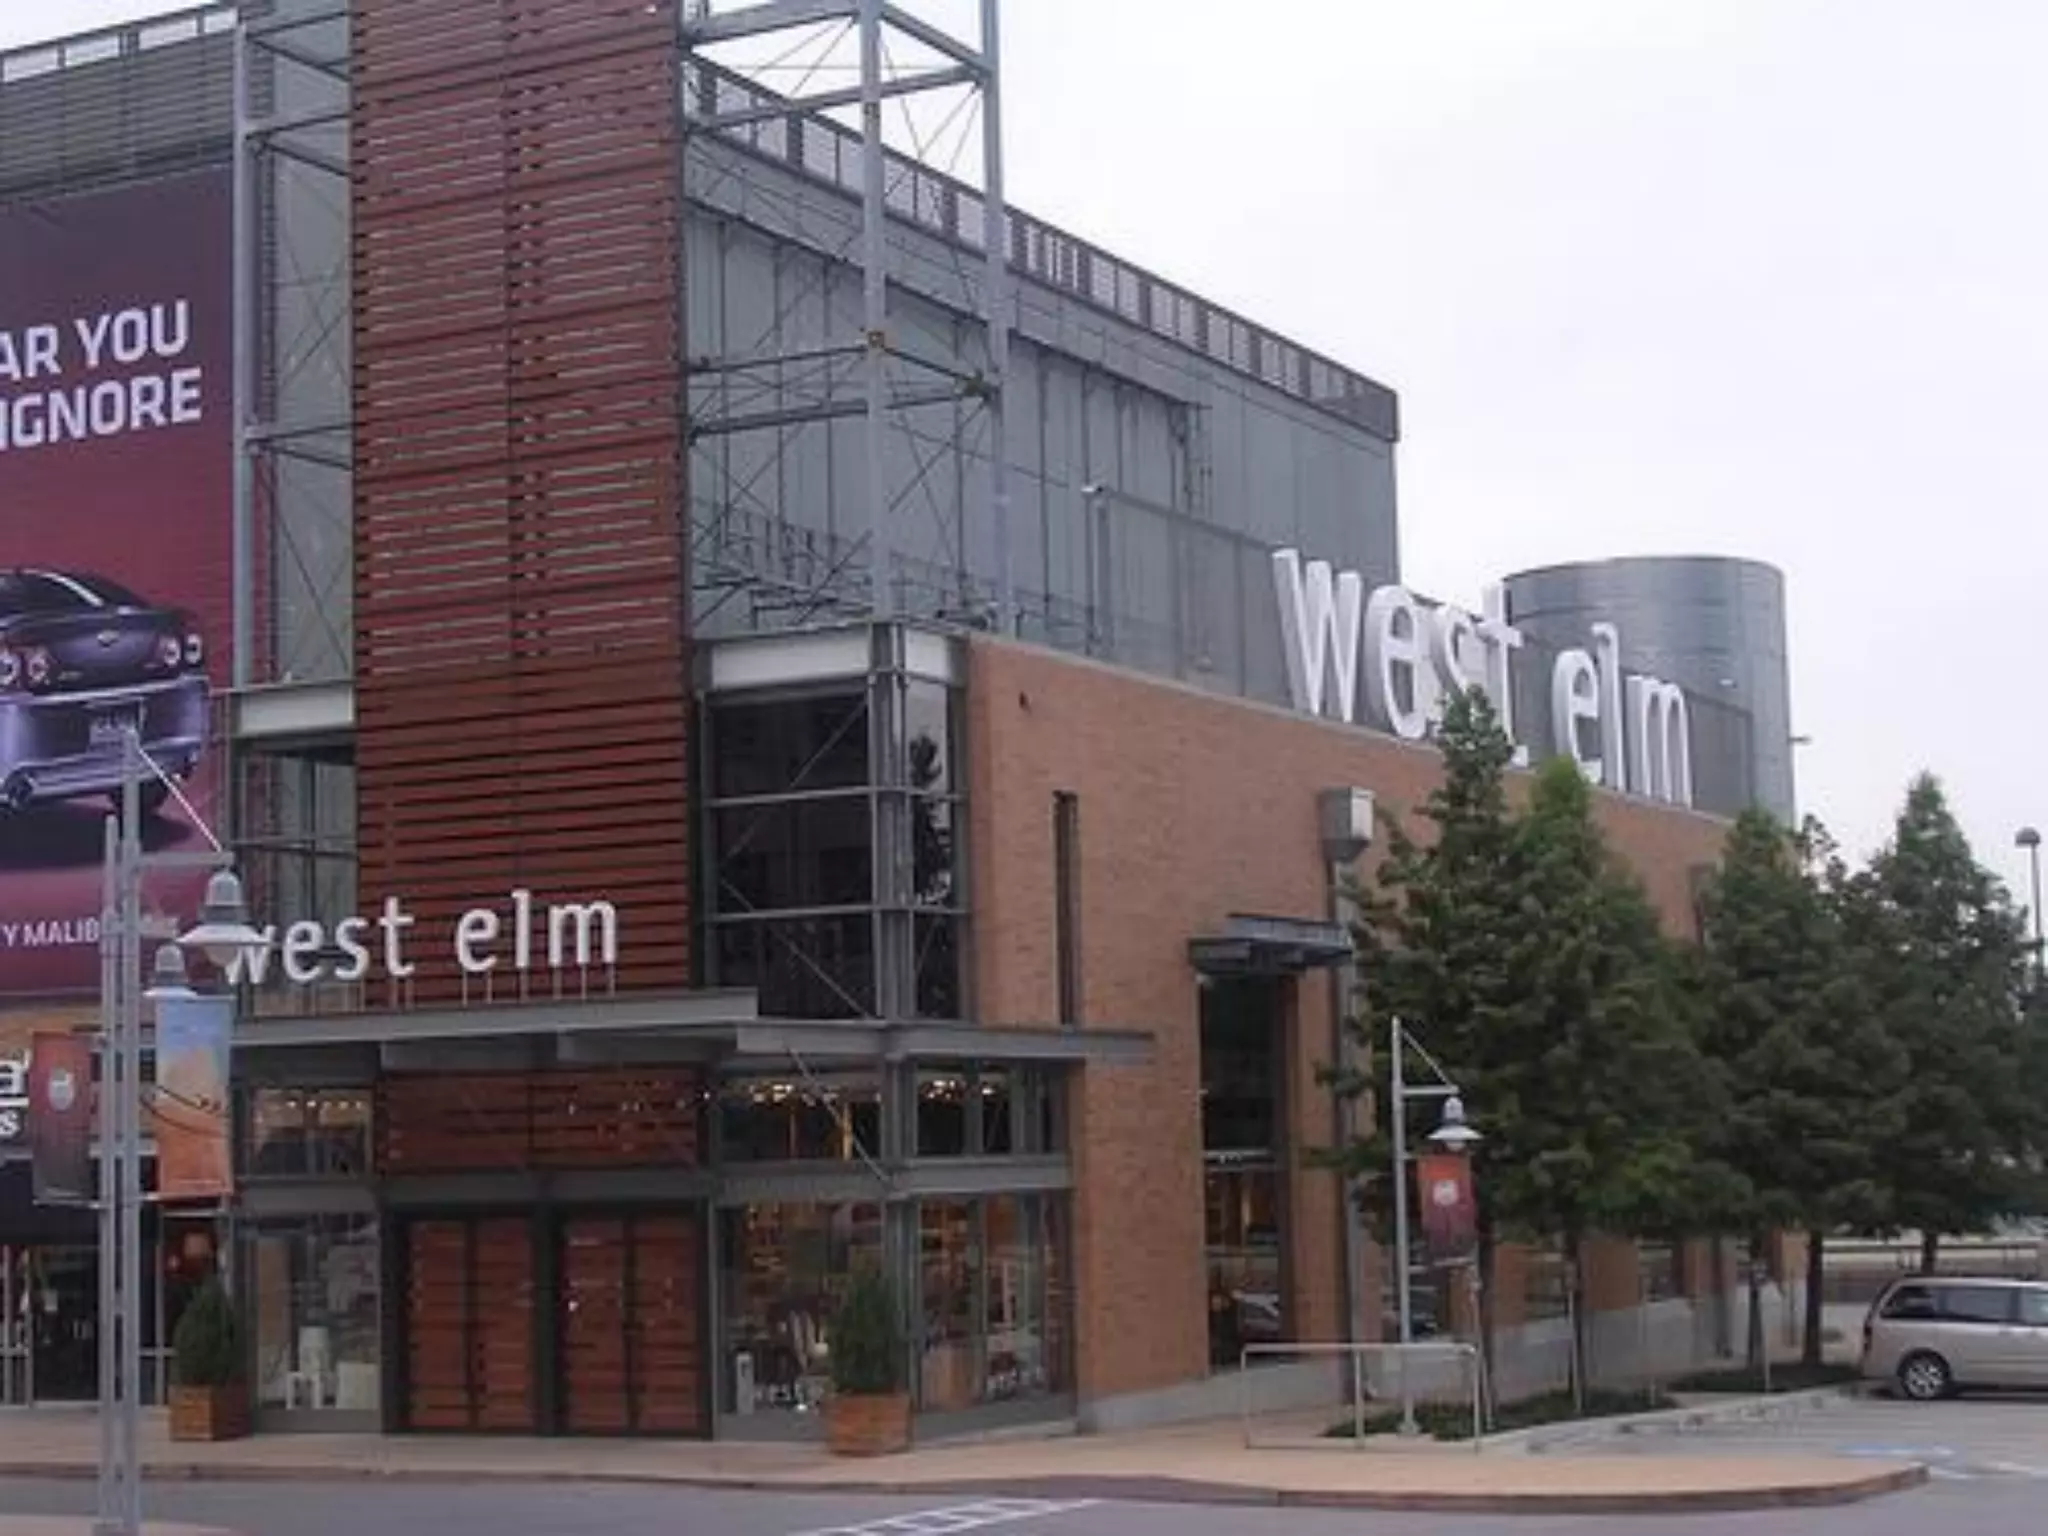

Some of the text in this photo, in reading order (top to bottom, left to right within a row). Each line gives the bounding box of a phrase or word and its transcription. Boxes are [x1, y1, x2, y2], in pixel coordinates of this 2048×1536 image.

[74, 299, 189, 368] YOU
[0, 366, 202, 451] IGNORE
[1272, 548, 1694, 813] west elm
[23, 916, 101, 946] MALIB
[224, 889, 618, 986] west elm
